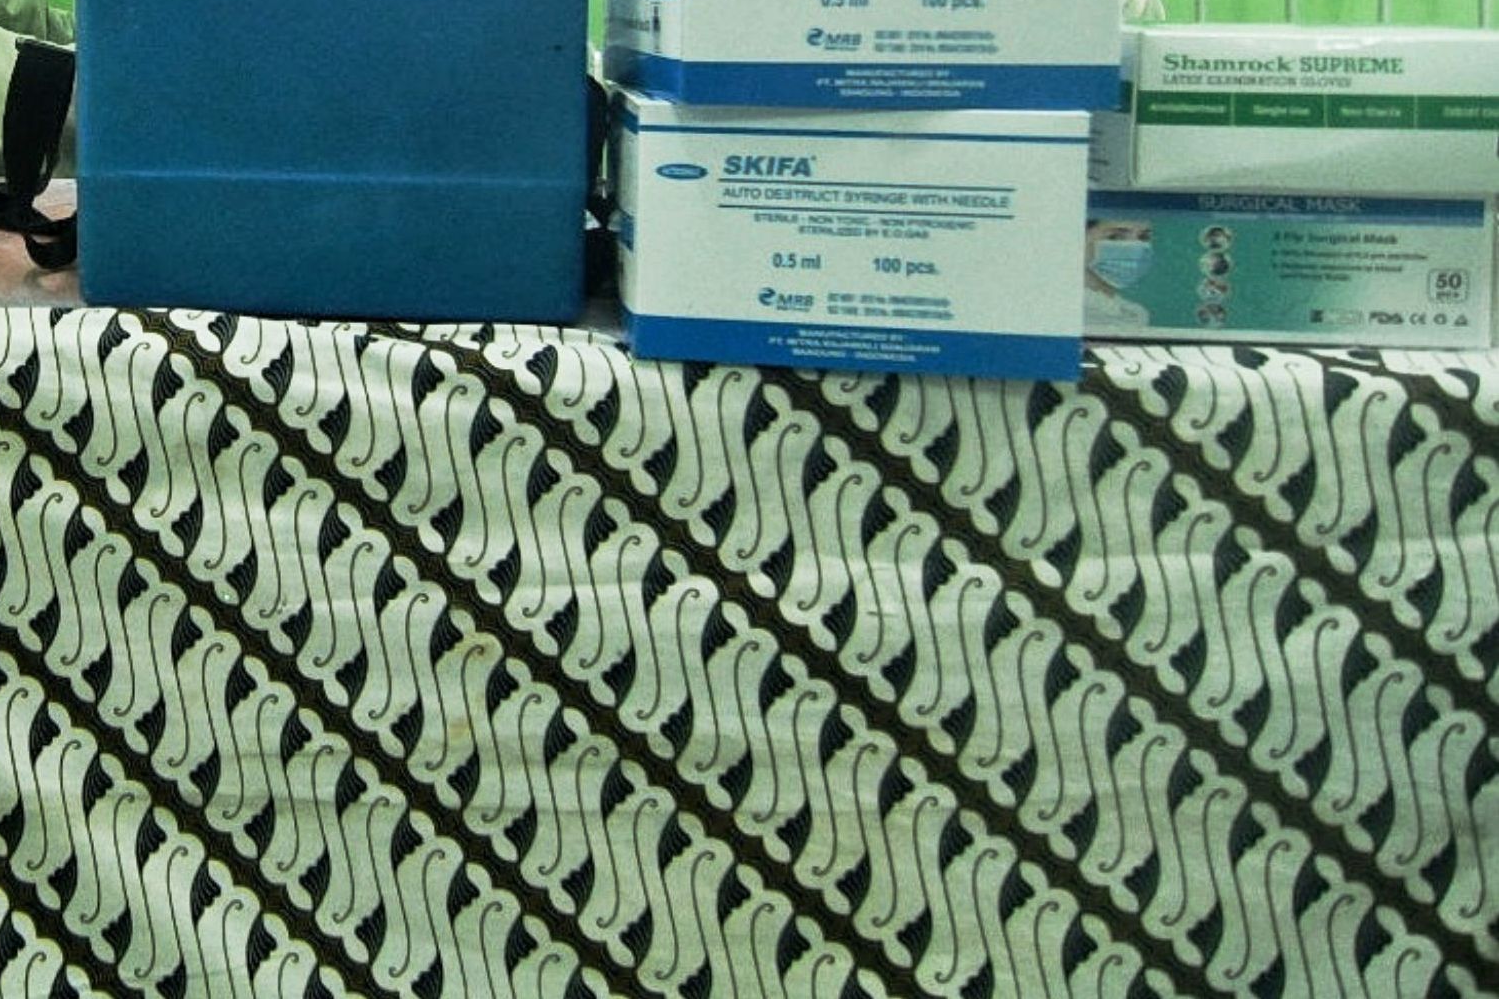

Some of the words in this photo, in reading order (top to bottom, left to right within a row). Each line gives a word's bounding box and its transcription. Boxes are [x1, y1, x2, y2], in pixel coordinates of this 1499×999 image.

[1163, 53, 1293, 72] Shamrock
[1299, 56, 1404, 74] SUPREME
[1162, 74, 1203, 85] LATEX
[723, 155, 811, 177] SKIFA
[723, 188, 762, 200] AUTO
[765, 188, 841, 202] DESTRUCT
[843, 190, 908, 205] SYRINGE
[911, 193, 948, 206] WITH
[951, 195, 1011, 208] NEEDLE
[773, 253, 797, 268] 0.5
[801, 254, 821, 270] ml
[873, 258, 901, 273] 100
[1436, 274, 1462, 289] 50
